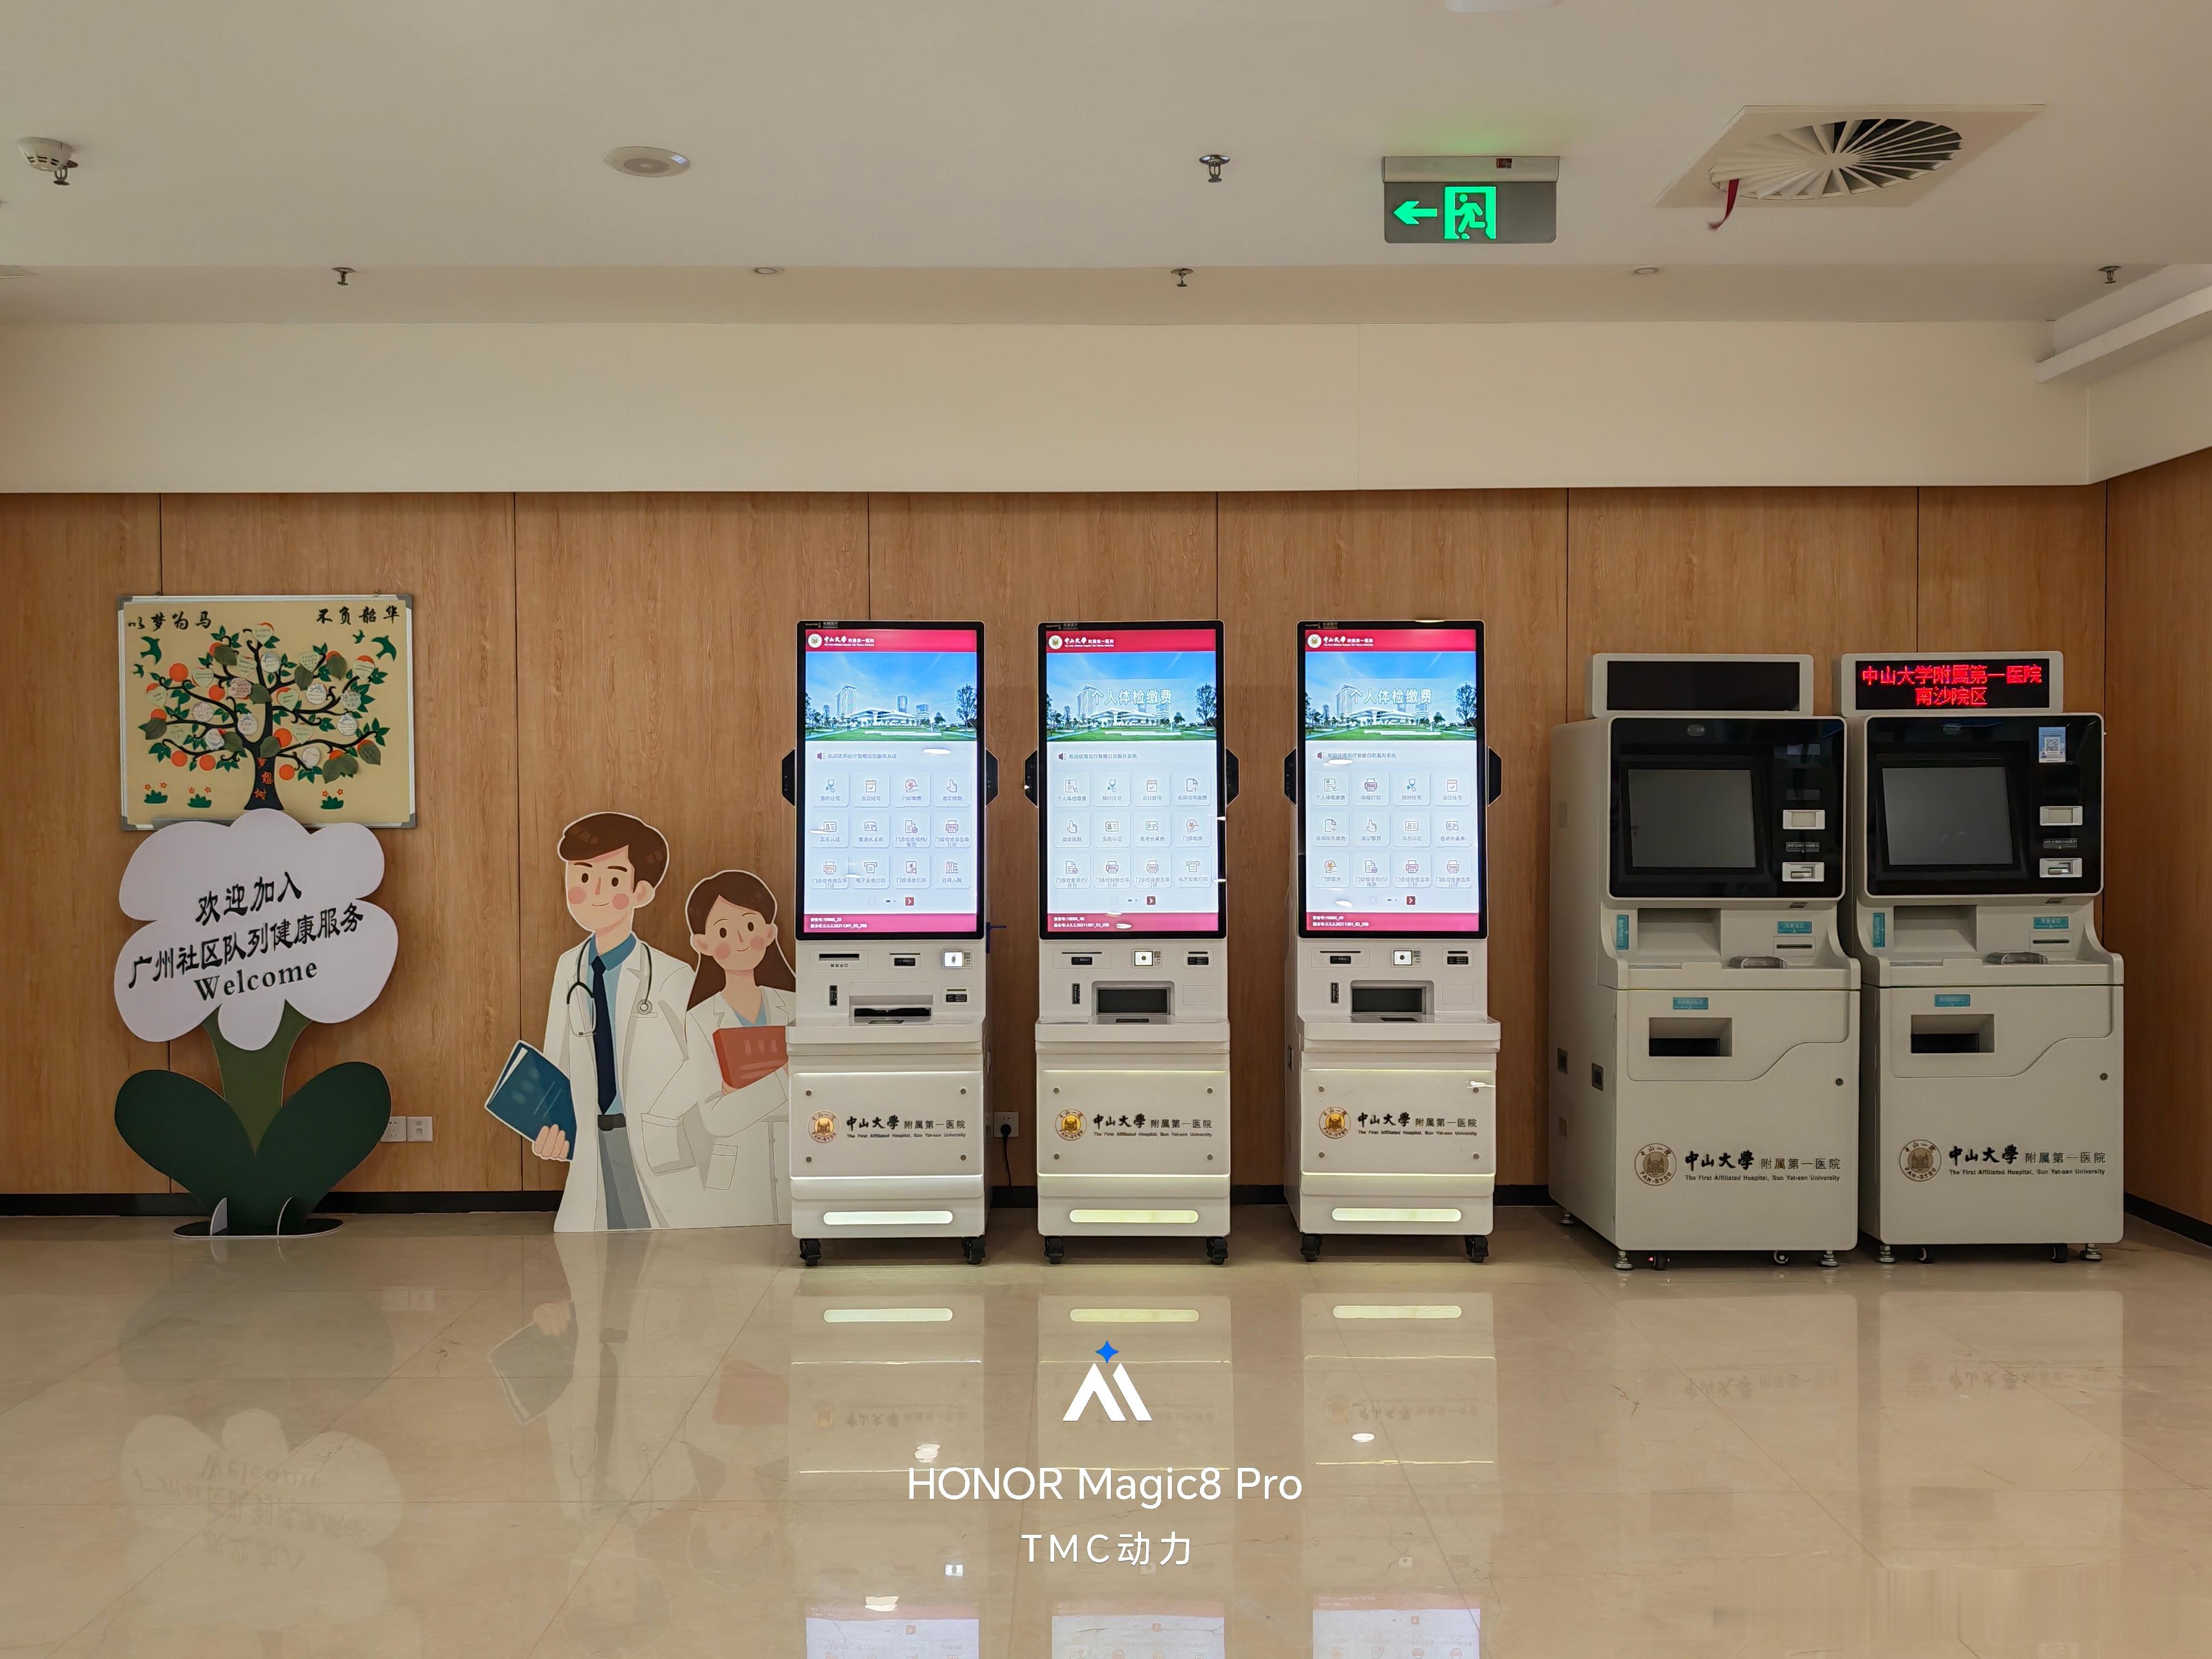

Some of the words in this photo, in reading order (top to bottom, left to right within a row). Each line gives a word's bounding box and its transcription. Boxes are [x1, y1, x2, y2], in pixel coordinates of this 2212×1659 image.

[127, 610, 212, 632] 以梦为马
[316, 605, 400, 625] 不负韶华
[1863, 664, 2042, 685] 中山大学附属第一医院
[1091, 688, 1173, 705] 个人体检缴费
[1350, 687, 1432, 705] 个人体检缴费
[1914, 686, 1988, 706] 南沙院区
[195, 871, 302, 926] 欢迎加入
[128, 902, 364, 989] 广州社区队列健康服务
[193, 962, 318, 1001] Welcome
